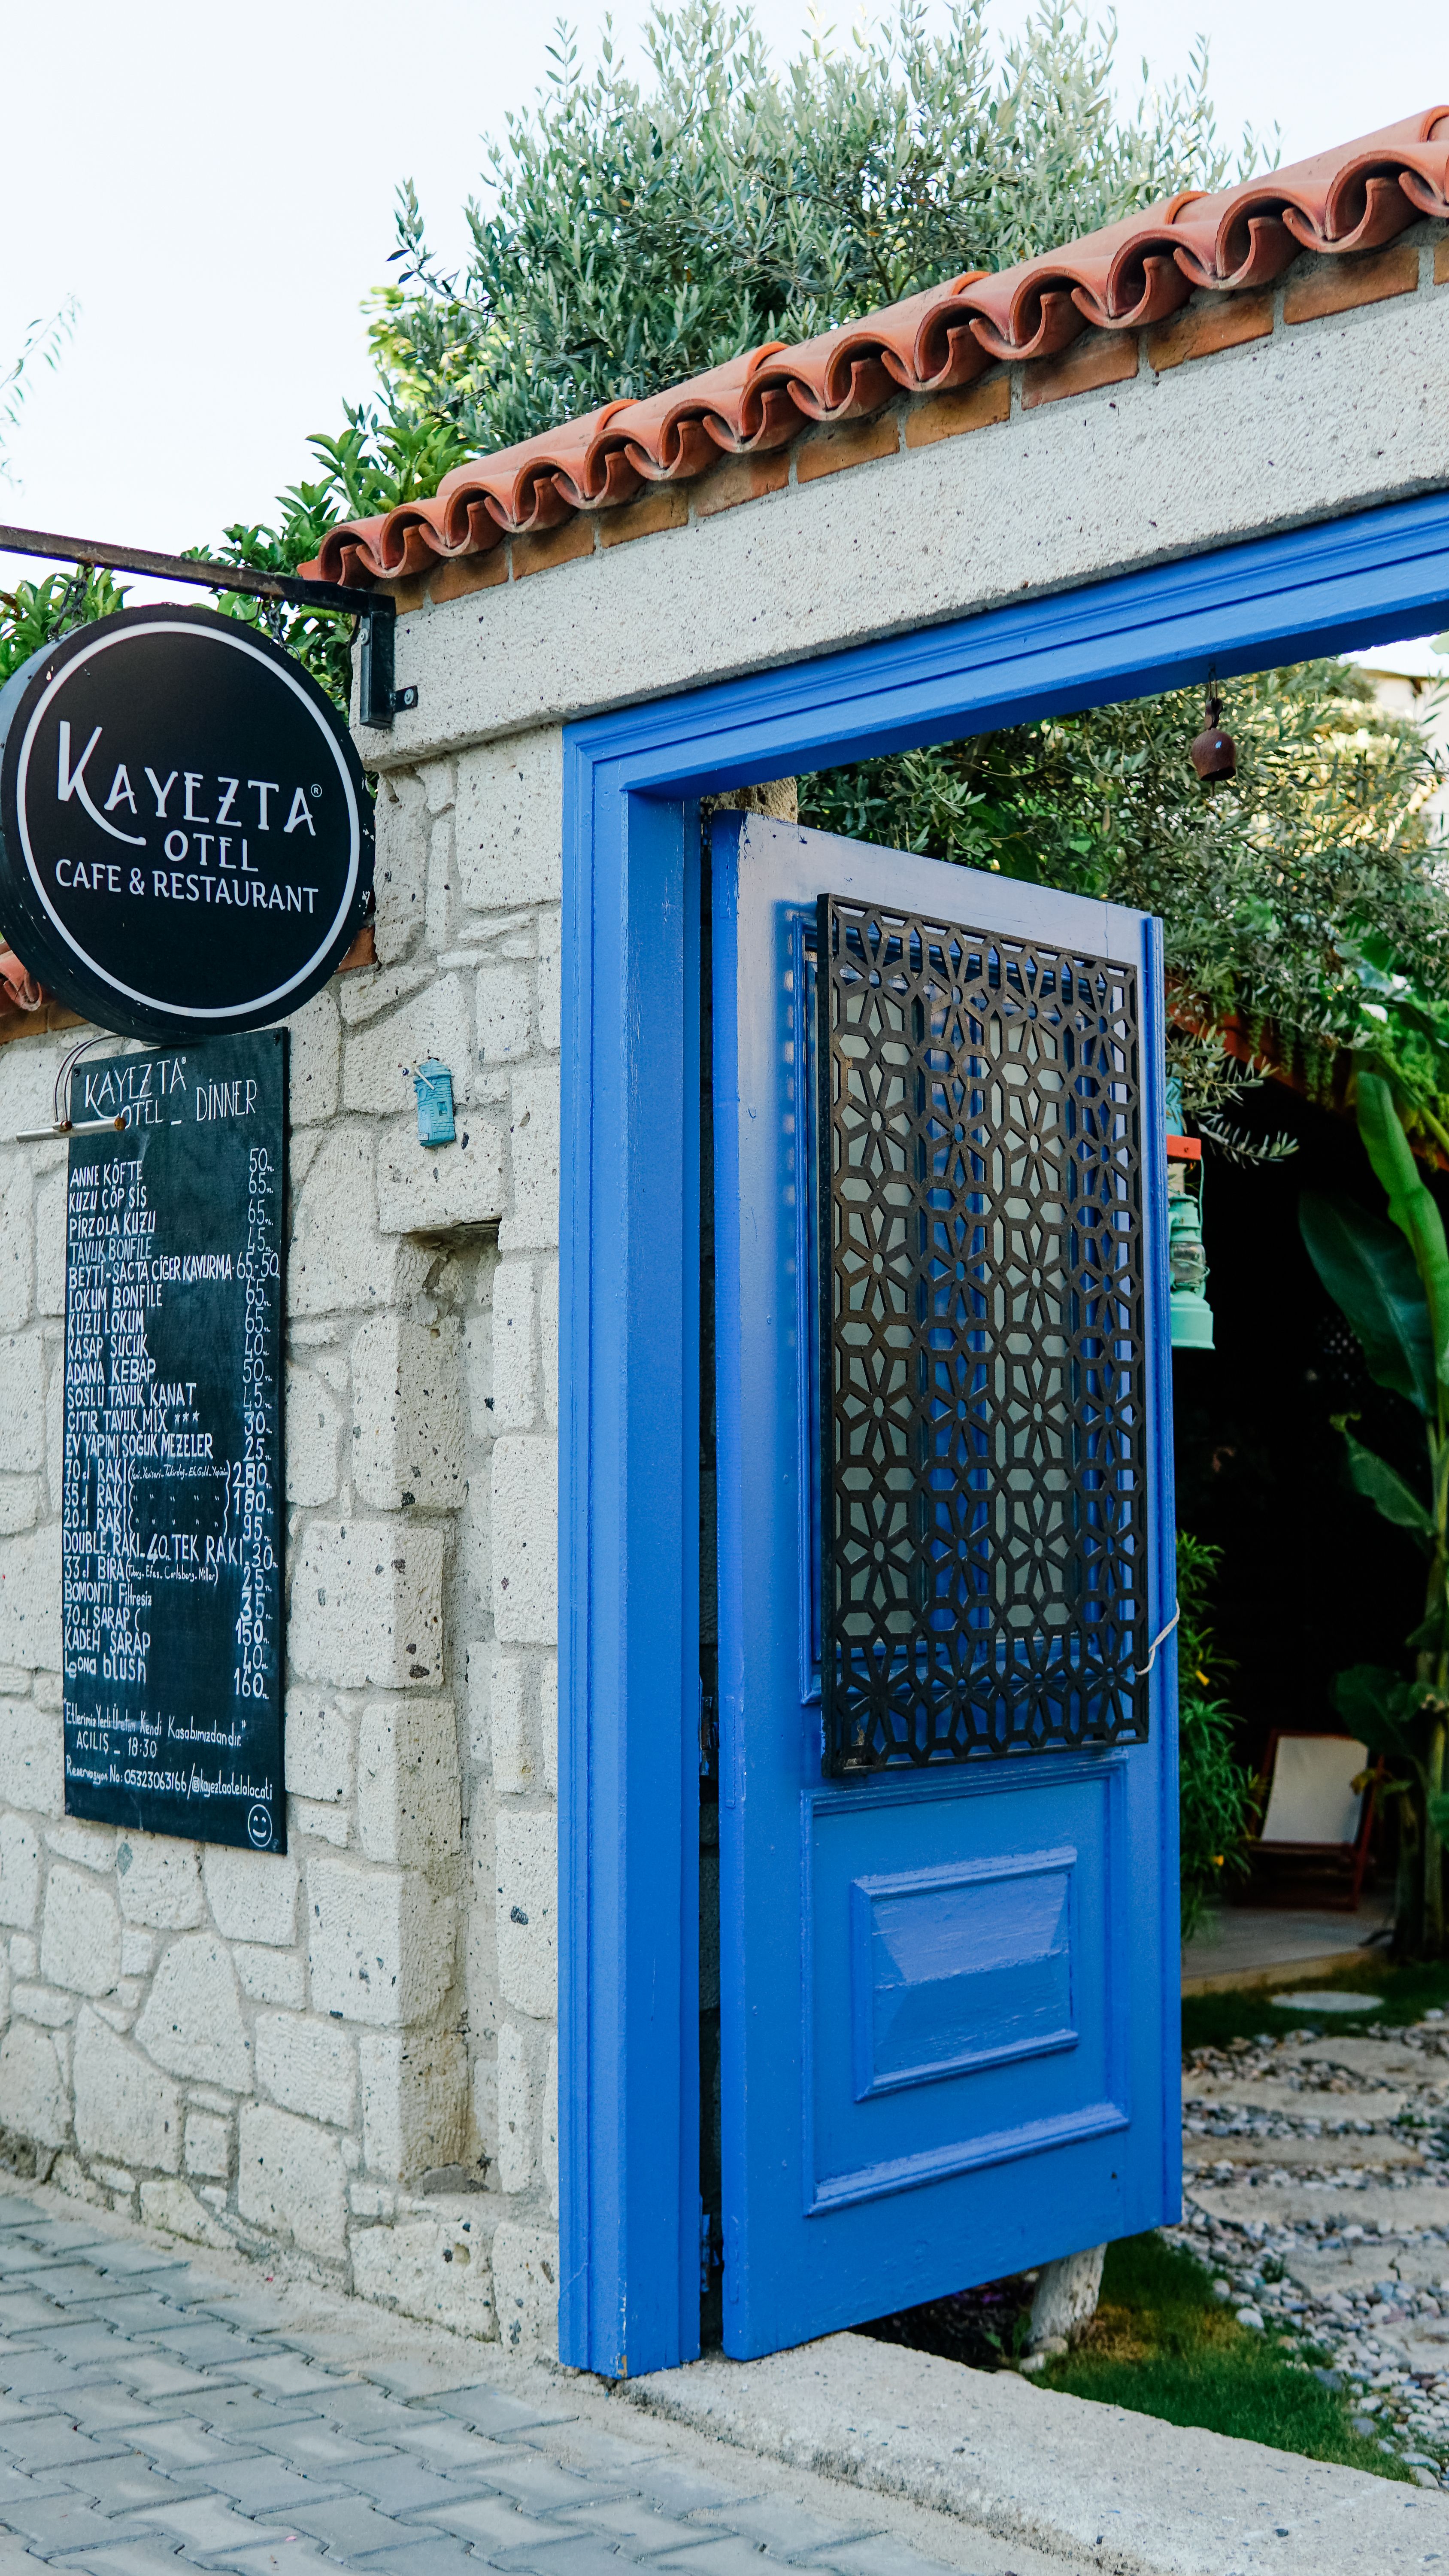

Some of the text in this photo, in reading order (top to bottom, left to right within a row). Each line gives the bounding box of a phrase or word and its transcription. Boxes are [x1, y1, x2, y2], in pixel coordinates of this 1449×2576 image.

[164, 830, 258, 872] OTEL
[56, 859, 319, 914] CAFE & RESTAURANT
[120, 1100, 163, 1129] OTEL
[70, 1165, 99, 1188] ANNE
[103, 1157, 142, 1186] KÖFTE
[69, 1190, 97, 1214] KUZU
[102, 1185, 125, 1210] ÇÖP
[69, 1214, 120, 1240] PİRZOLA
[123, 1210, 156, 1236] KUZU
[69, 1239, 106, 1265] TAVUK
[109, 1234, 152, 1261] BONFİLE
[69, 1287, 107, 1312] LOKUM
[112, 1280, 162, 1309] BONFİLE
[68, 1312, 100, 1338] KUZU
[104, 1309, 144, 1334] LOKUM
[67, 1337, 103, 1360] KASAP
[110, 1334, 148, 1358] SUCUK
[66, 1361, 105, 1385] ADANA
[112, 1358, 156, 1385] KEBAP
[67, 1386, 104, 1409] SOSLU
[108, 1383, 145, 1407] TAVUK
[150, 1382, 197, 1409] KANAT
[67, 1410, 98, 1433] ÇITIR
[103, 1409, 139, 1432] TAVUK
[66, 1433, 81, 1456] EV
[83, 1433, 119, 1458] YAPIMI
[122, 1430, 158, 1458] SOĞUK
[161, 1433, 213, 1459] MEZELER
[98, 1458, 126, 1484] RAKI
[97, 1483, 126, 1508] RAKI
[97, 1508, 126, 1533] RAKI
[64, 1530, 106, 1554] DOUBLE
[172, 1534, 199, 1562] TEK
[64, 1626, 100, 1652] KADEH
[103, 1653, 146, 1683] blush
[140, 1710, 162, 1735] Kendi
[128, 1737, 157, 1758] 18:30
